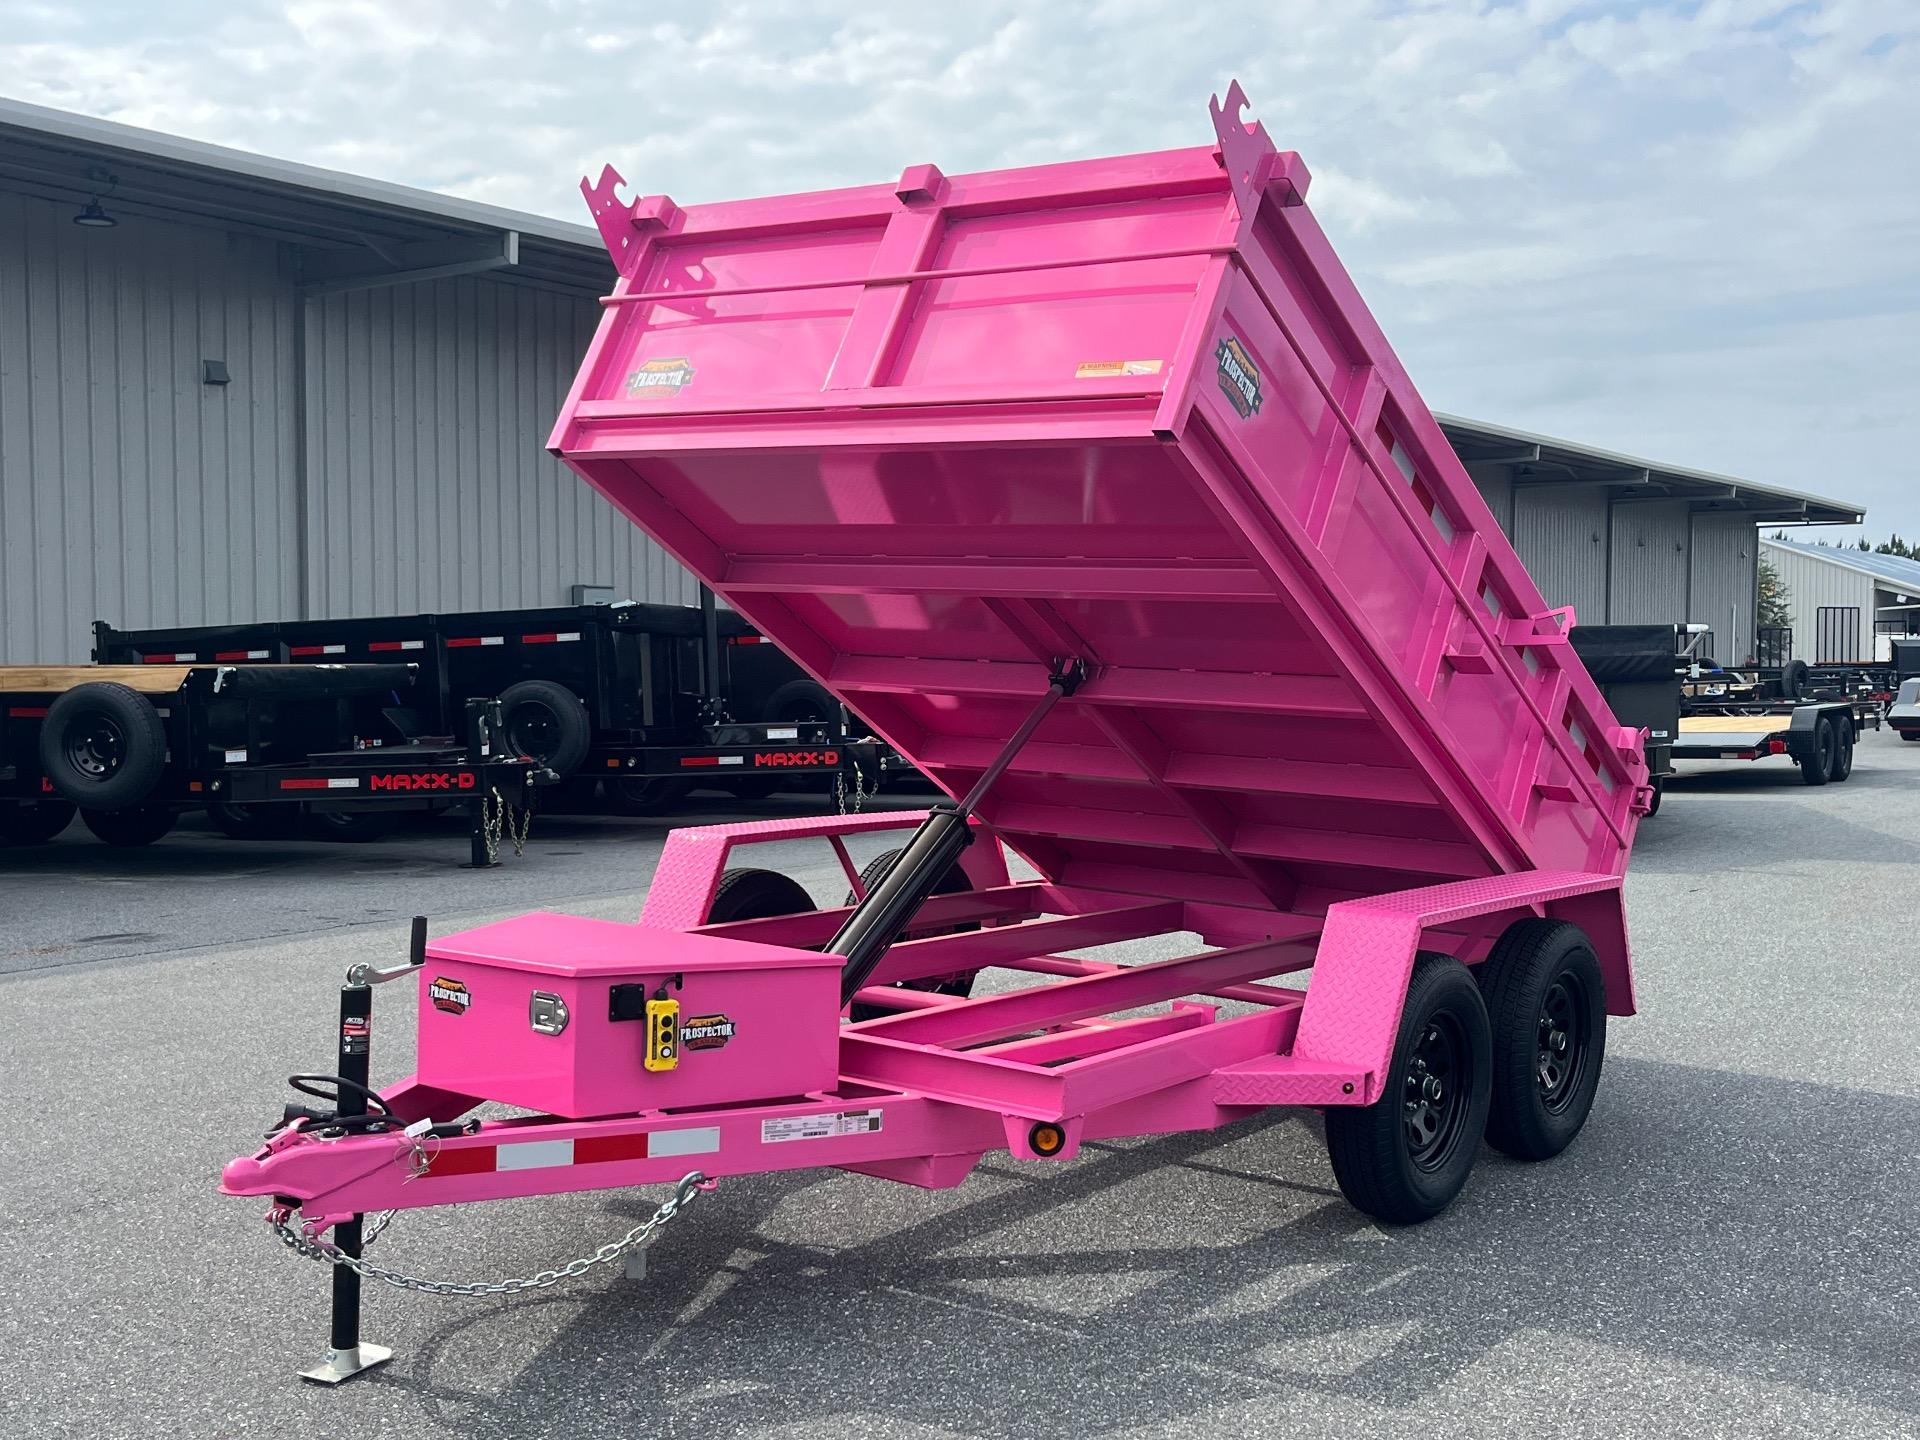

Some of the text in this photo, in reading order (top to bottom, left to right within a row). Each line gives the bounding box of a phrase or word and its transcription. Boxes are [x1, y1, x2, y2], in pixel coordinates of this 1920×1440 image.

[1220, 346, 1256, 407] PROSPECTOR
[757, 751, 838, 767] MAXX-D
[371, 773, 475, 790] MAXX-D
[430, 984, 469, 1006] PROSPECTOR
[680, 1023, 733, 1041] PROSPECTOR
